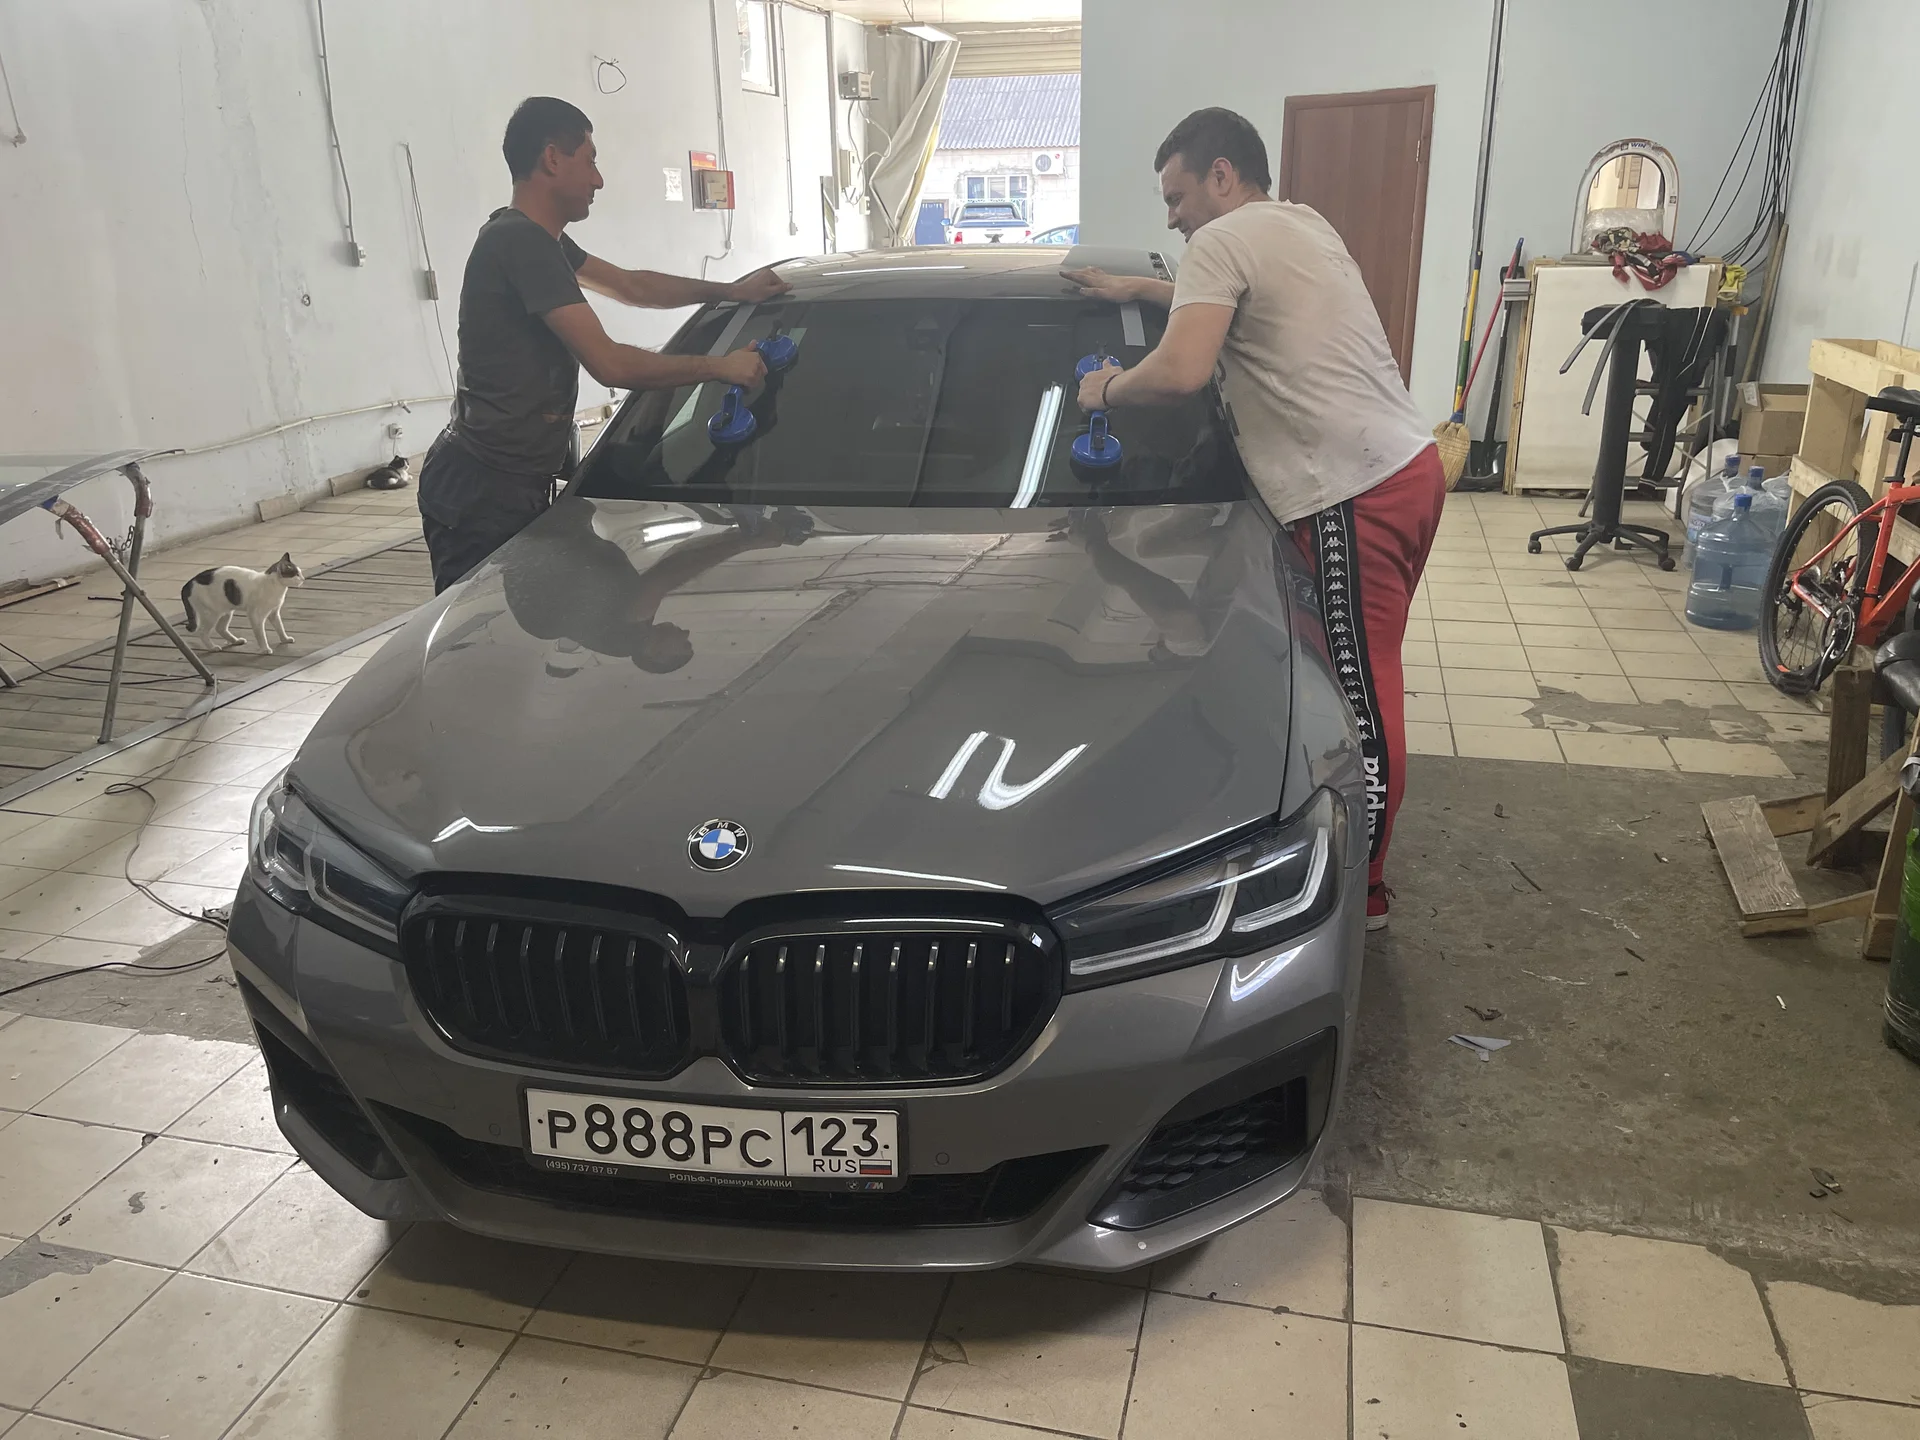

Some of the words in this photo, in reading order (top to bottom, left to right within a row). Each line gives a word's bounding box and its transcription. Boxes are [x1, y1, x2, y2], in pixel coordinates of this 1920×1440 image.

[699, 821, 745, 838] BMW
[791, 1117, 878, 1158] 123
[545, 1160, 570, 1171] (495)
[572, 1163, 589, 1172] 737
[813, 1159, 857, 1174] RUS
[756, 1179, 793, 1188] ХИМКИ
